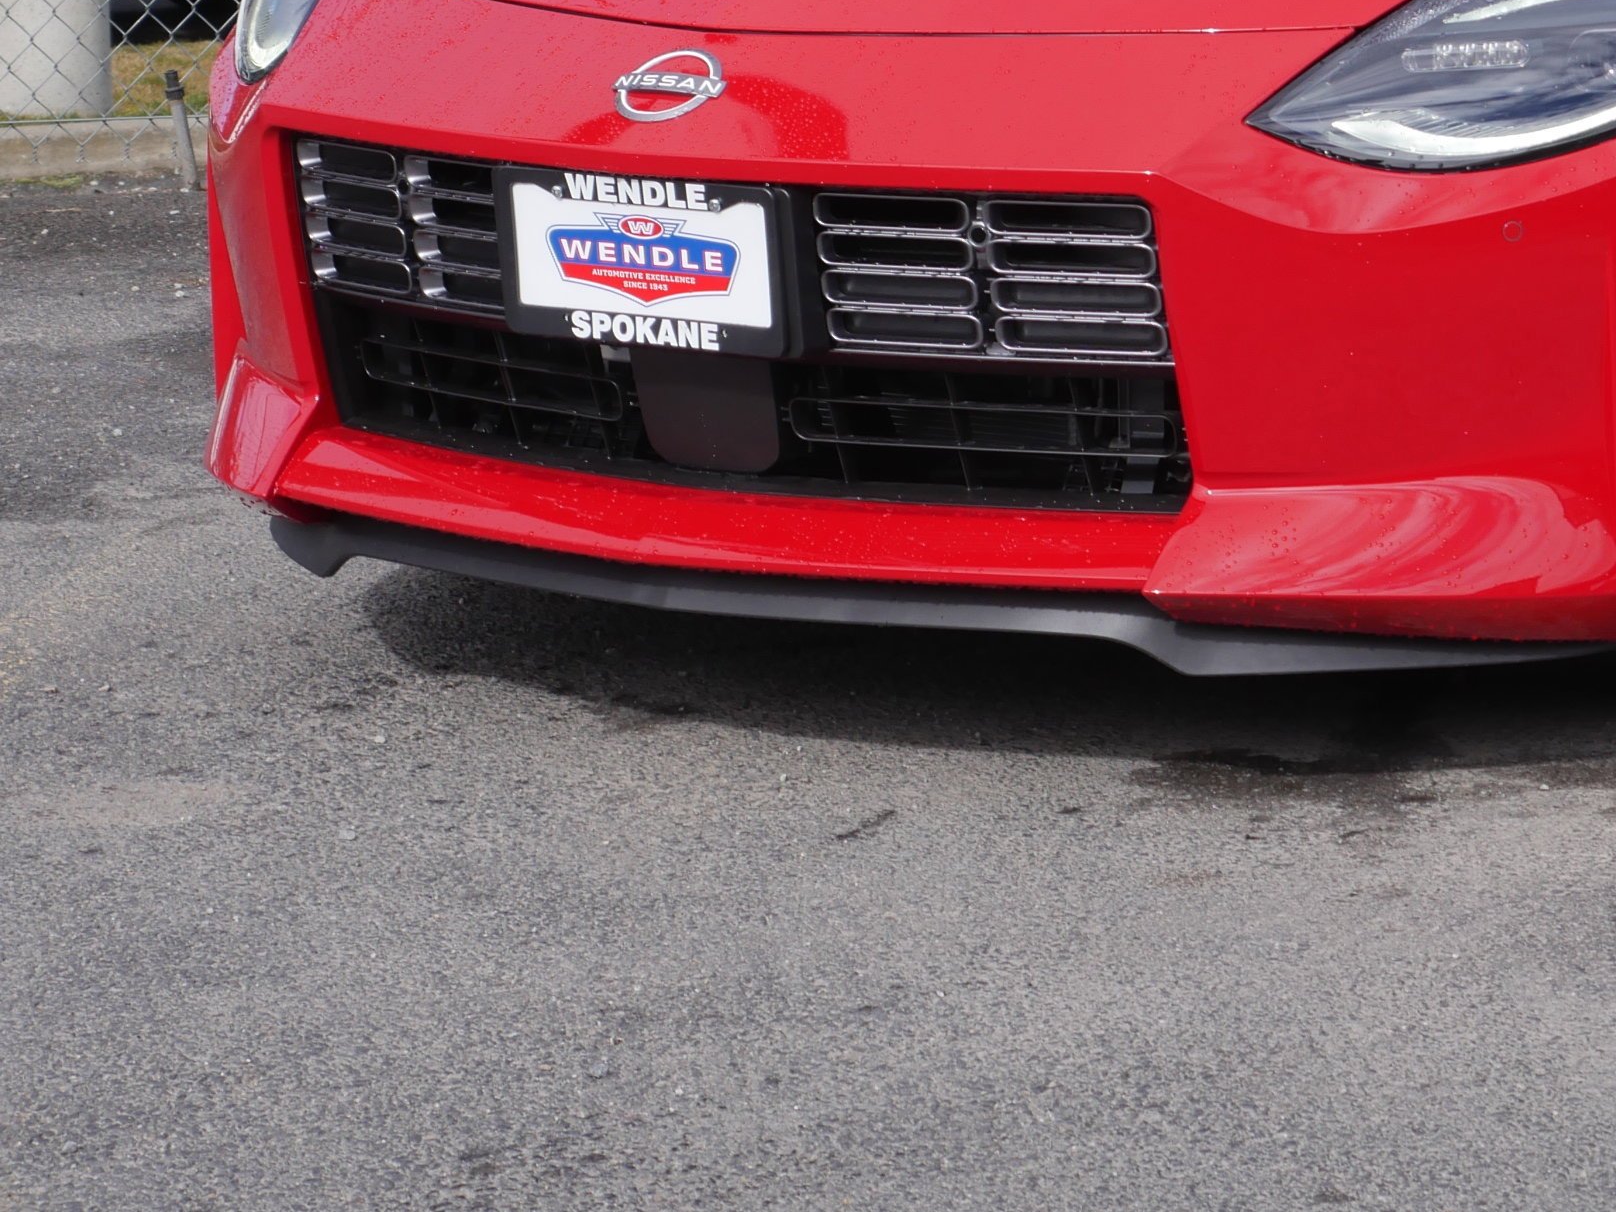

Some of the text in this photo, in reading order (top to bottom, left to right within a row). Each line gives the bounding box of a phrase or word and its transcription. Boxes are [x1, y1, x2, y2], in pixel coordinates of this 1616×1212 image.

[614, 73, 723, 94] NISSAN
[564, 173, 709, 211] WENDLE
[560, 237, 724, 273] WENDLE
[591, 268, 696, 285] AUTOMOTIVE EXCELLENCE
[623, 280, 668, 292] SINCE 1943
[571, 311, 720, 351] SPOKANE
